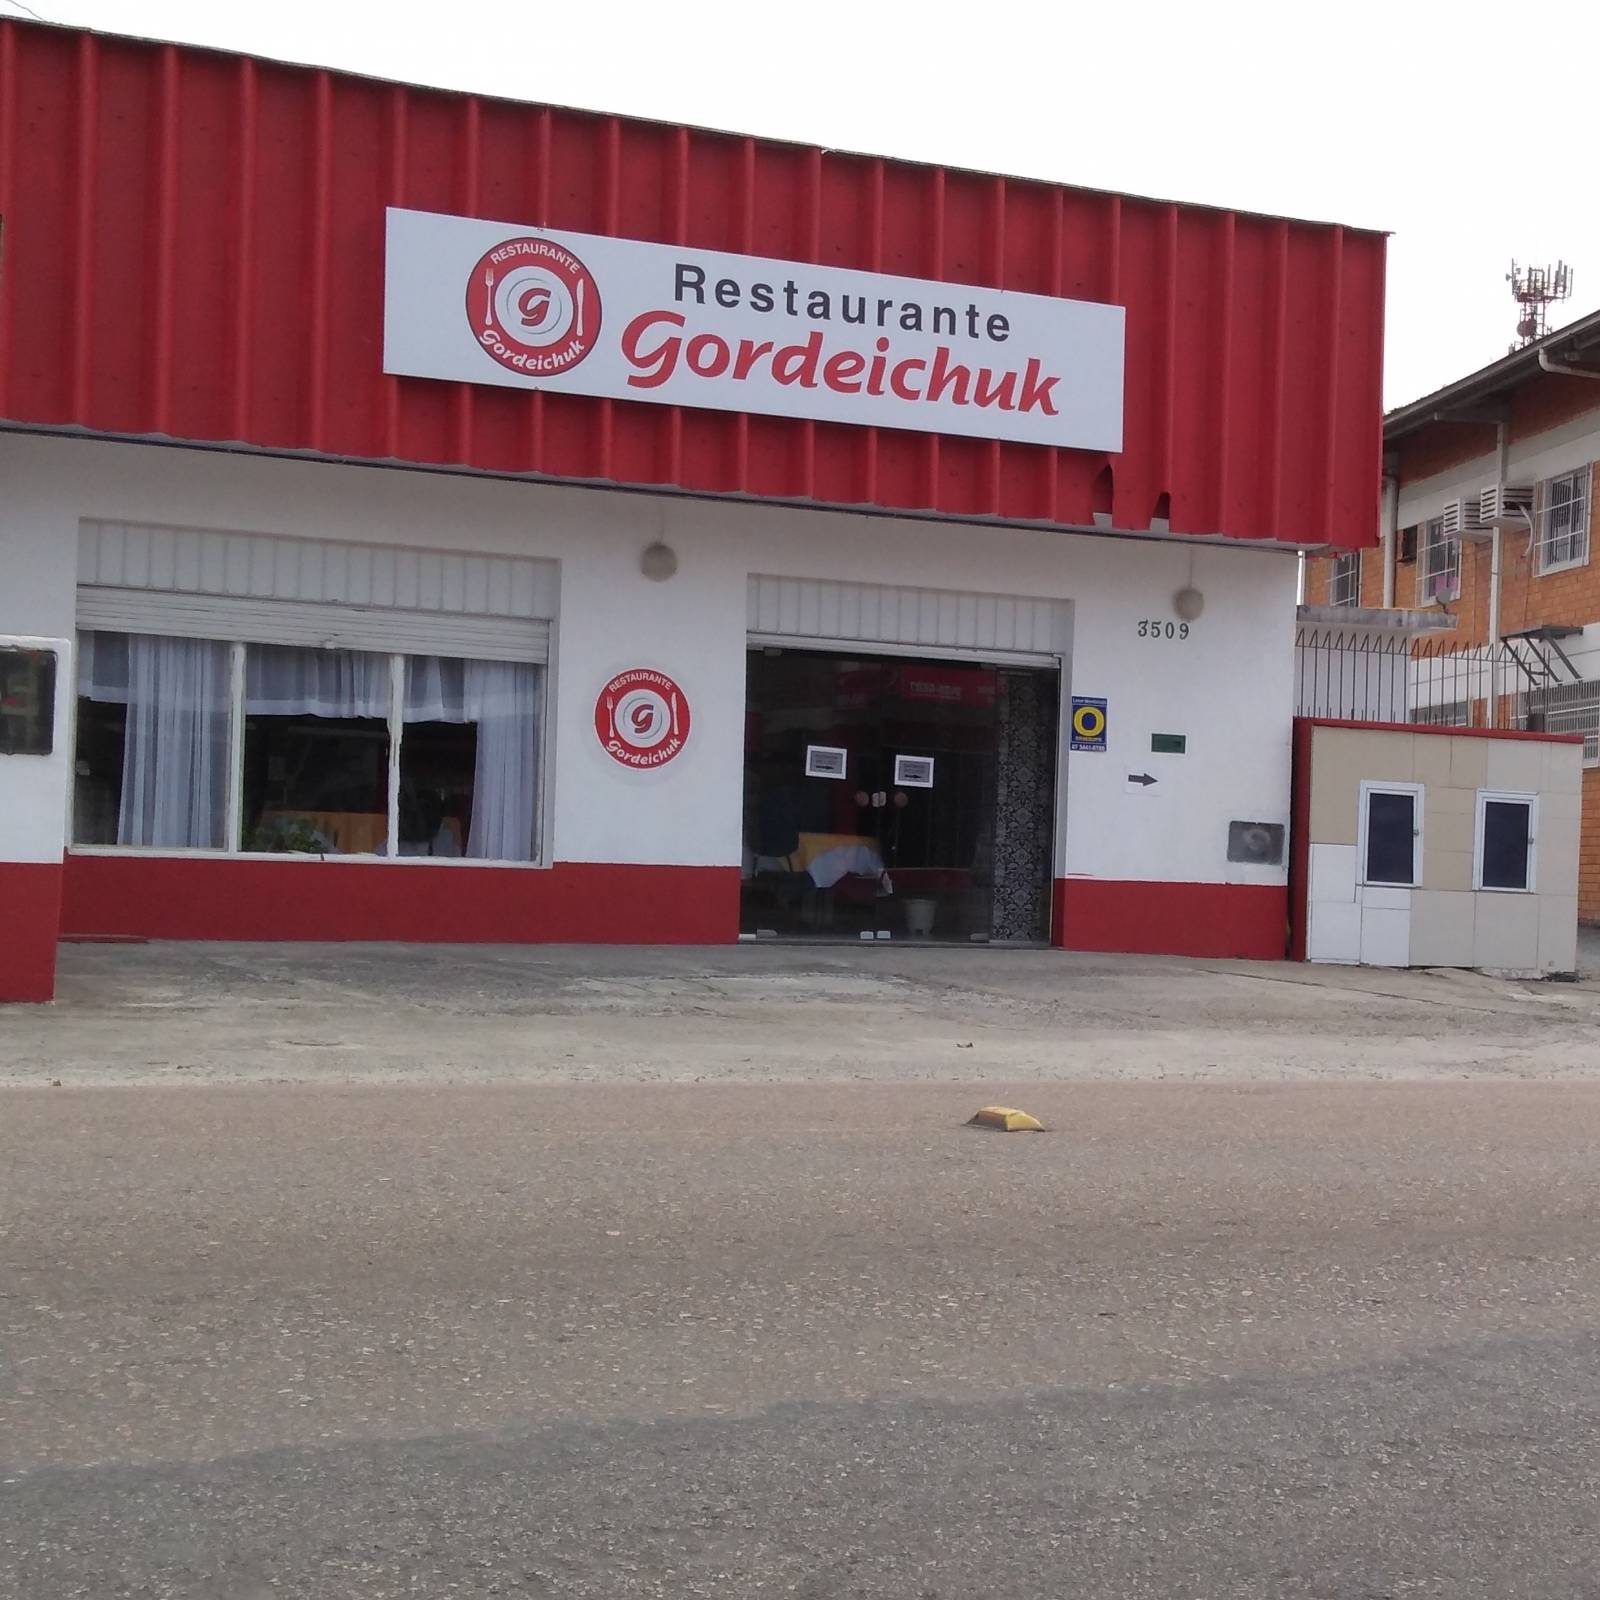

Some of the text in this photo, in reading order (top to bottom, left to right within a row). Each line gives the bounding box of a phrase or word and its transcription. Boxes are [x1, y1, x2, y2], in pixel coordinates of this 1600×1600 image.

[490, 242, 580, 274] RESTAURANTE
[674, 263, 1011, 342] Restaurante
[480, 329, 585, 370] Gordeichuk
[621, 310, 1062, 416] Gordeichuk
[1138, 619, 1189, 640] 3509
[608, 672, 673, 692] RESTAURANTE
[606, 738, 680, 764] Gordeichuk
